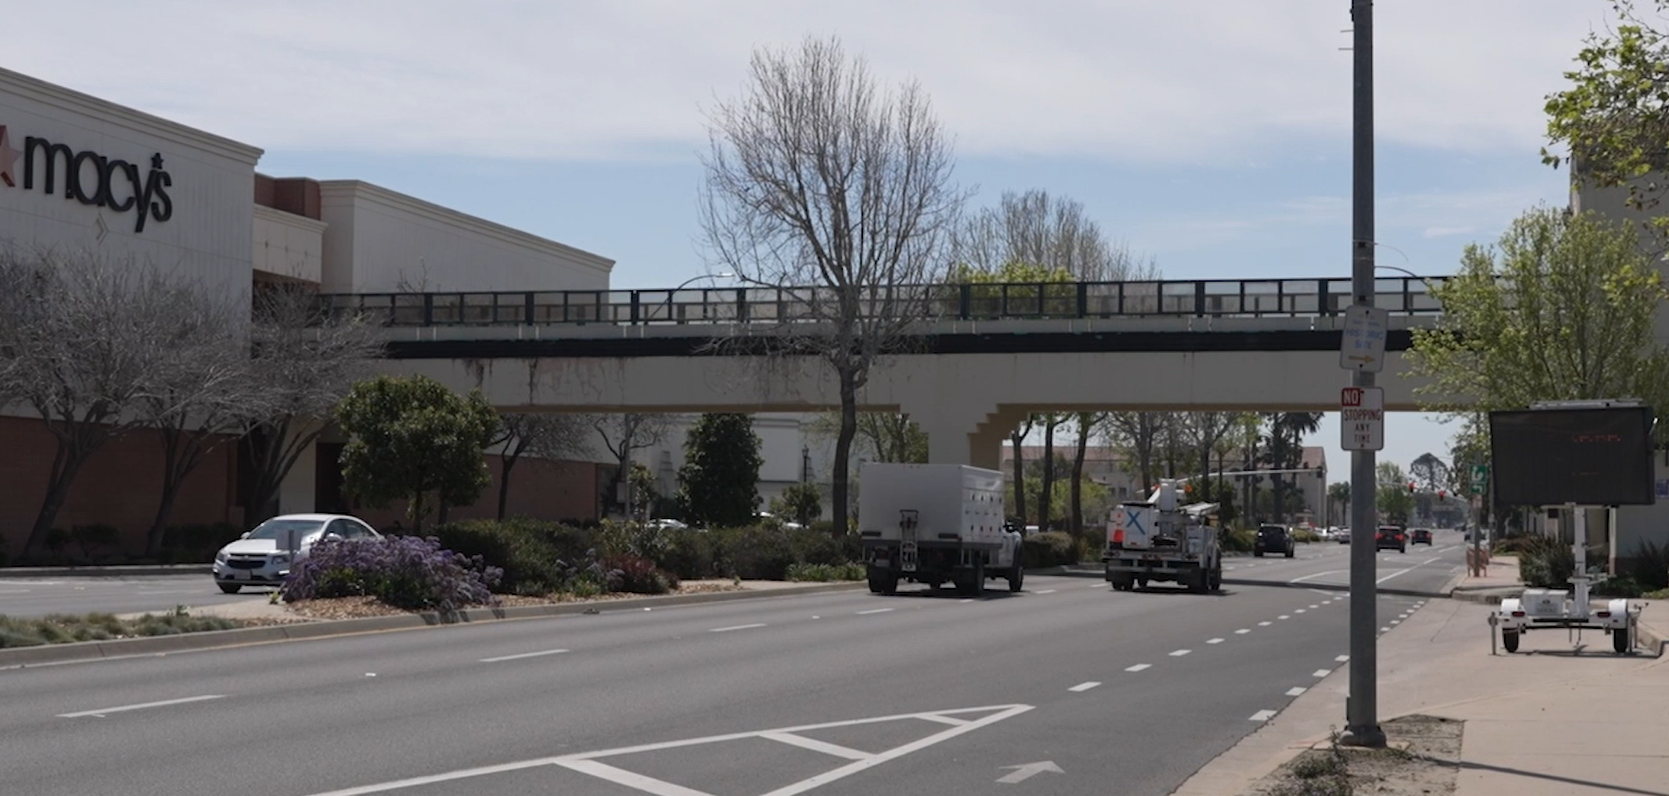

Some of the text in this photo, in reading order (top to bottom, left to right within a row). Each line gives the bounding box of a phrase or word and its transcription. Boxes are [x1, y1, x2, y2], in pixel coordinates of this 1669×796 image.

[1343, 390, 1359, 404] NO
[1344, 408, 1381, 421] STOPPING
[1355, 423, 1370, 432] ANY
[1354, 434, 1371, 443] TIME
